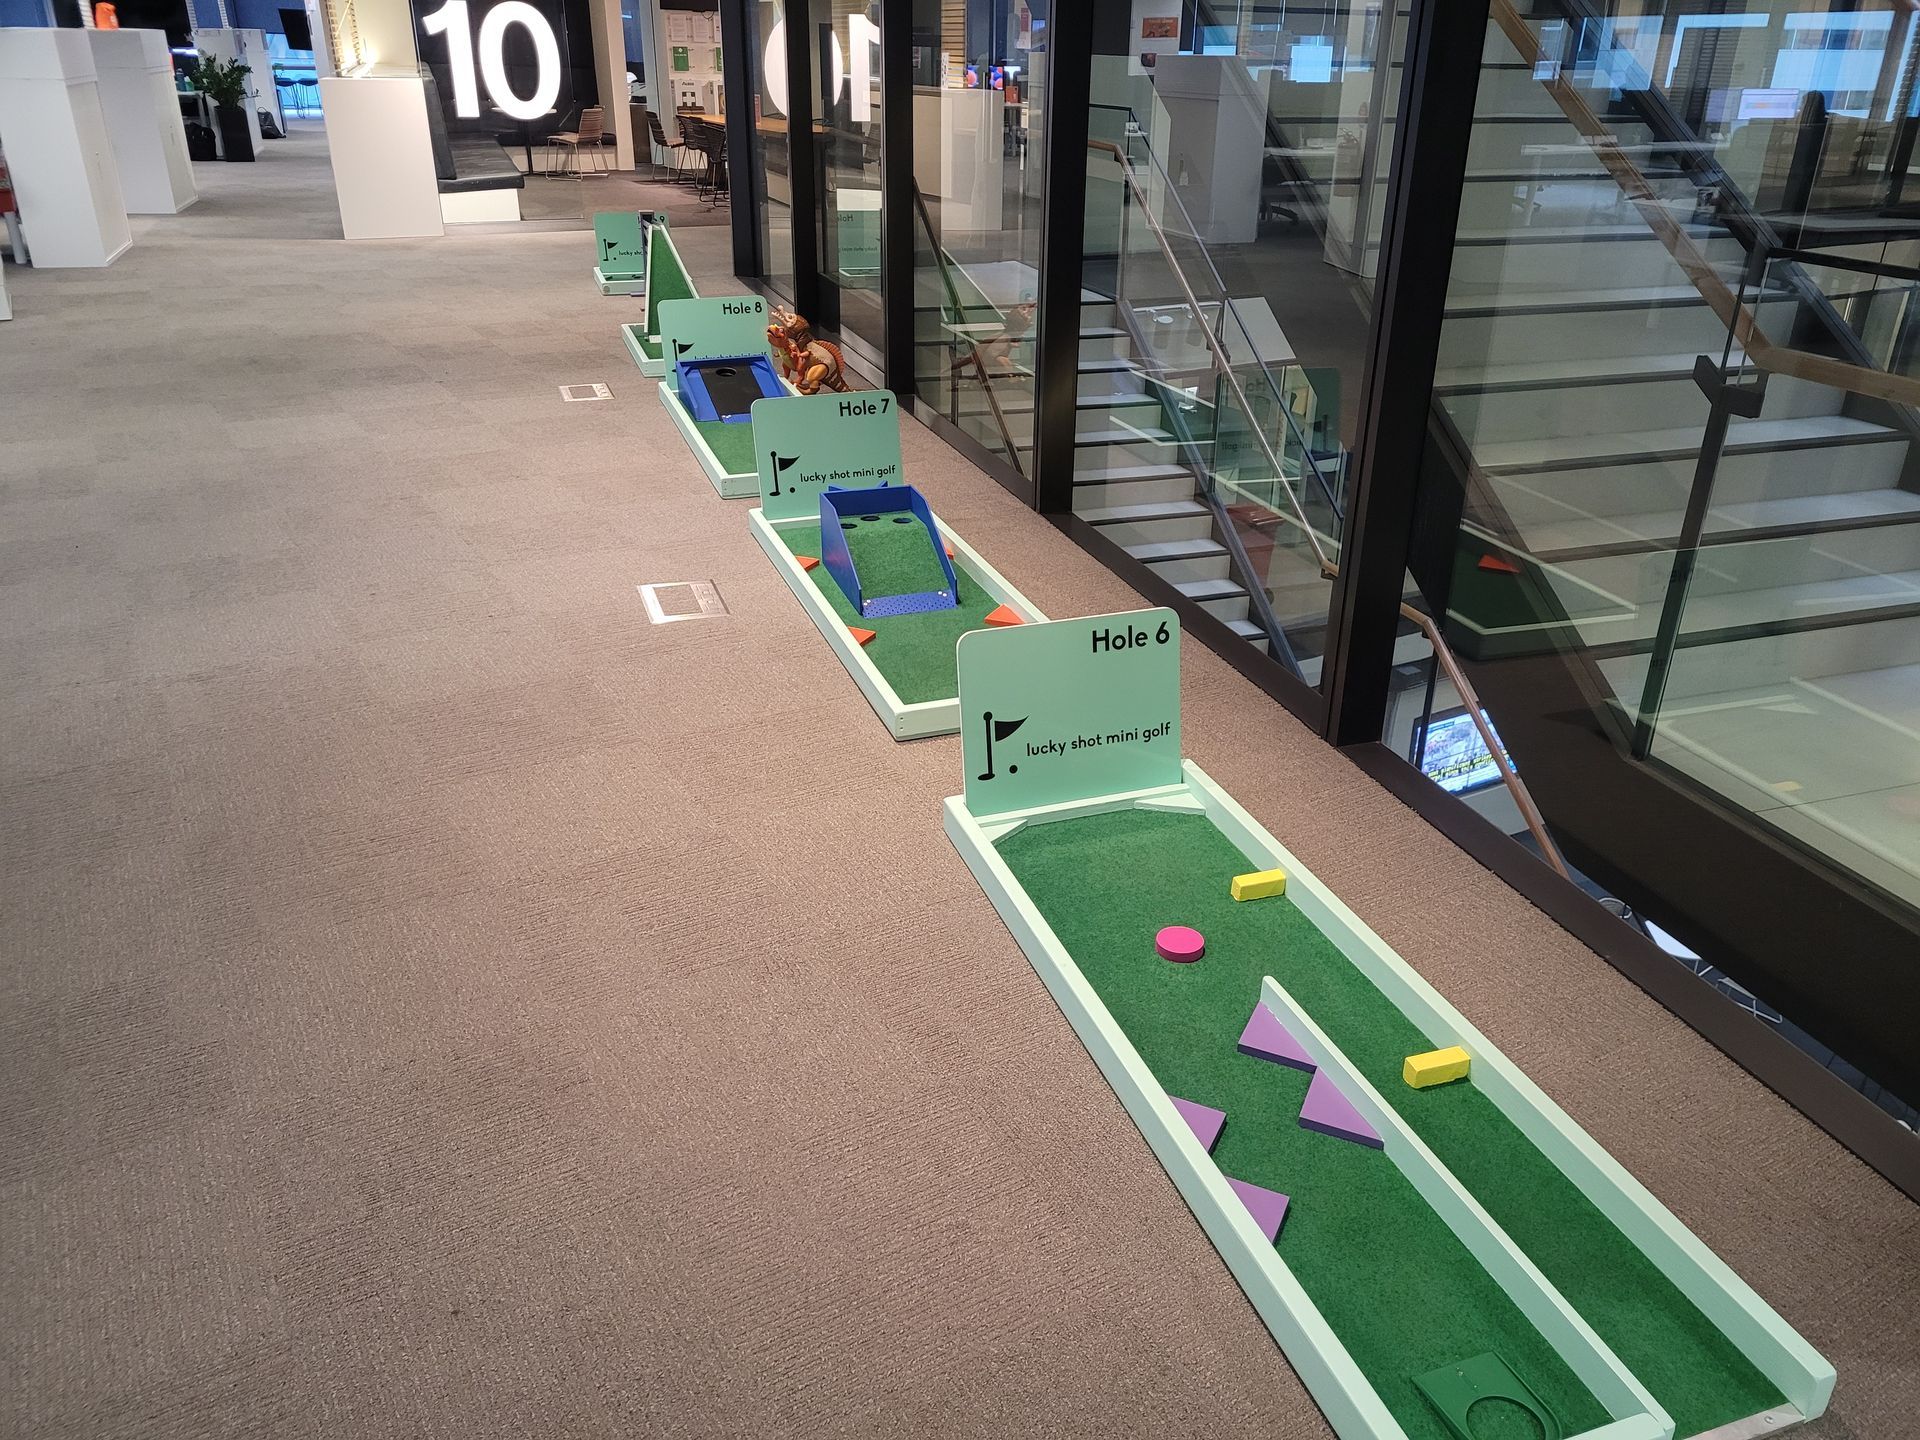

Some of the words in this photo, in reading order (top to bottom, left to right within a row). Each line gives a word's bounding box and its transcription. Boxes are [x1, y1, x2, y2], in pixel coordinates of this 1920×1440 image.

[422, 0, 561, 120] 10
[722, 302, 751, 315] Hole
[754, 302, 763, 313] 8
[839, 400, 877, 417] Hole
[880, 398, 890, 414] 7
[800, 472, 827, 484] lucky
[829, 470, 851, 480] shot
[852, 467, 875, 478] mini
[876, 464, 896, 478] golf
[1092, 625, 1149, 653] Hole
[1155, 620, 1170, 645] 6
[1026, 740, 1067, 757] lucky
[1071, 734, 1102, 750] shot
[1106, 728, 1138, 745] mini
[1142, 721, 1171, 743] golf
